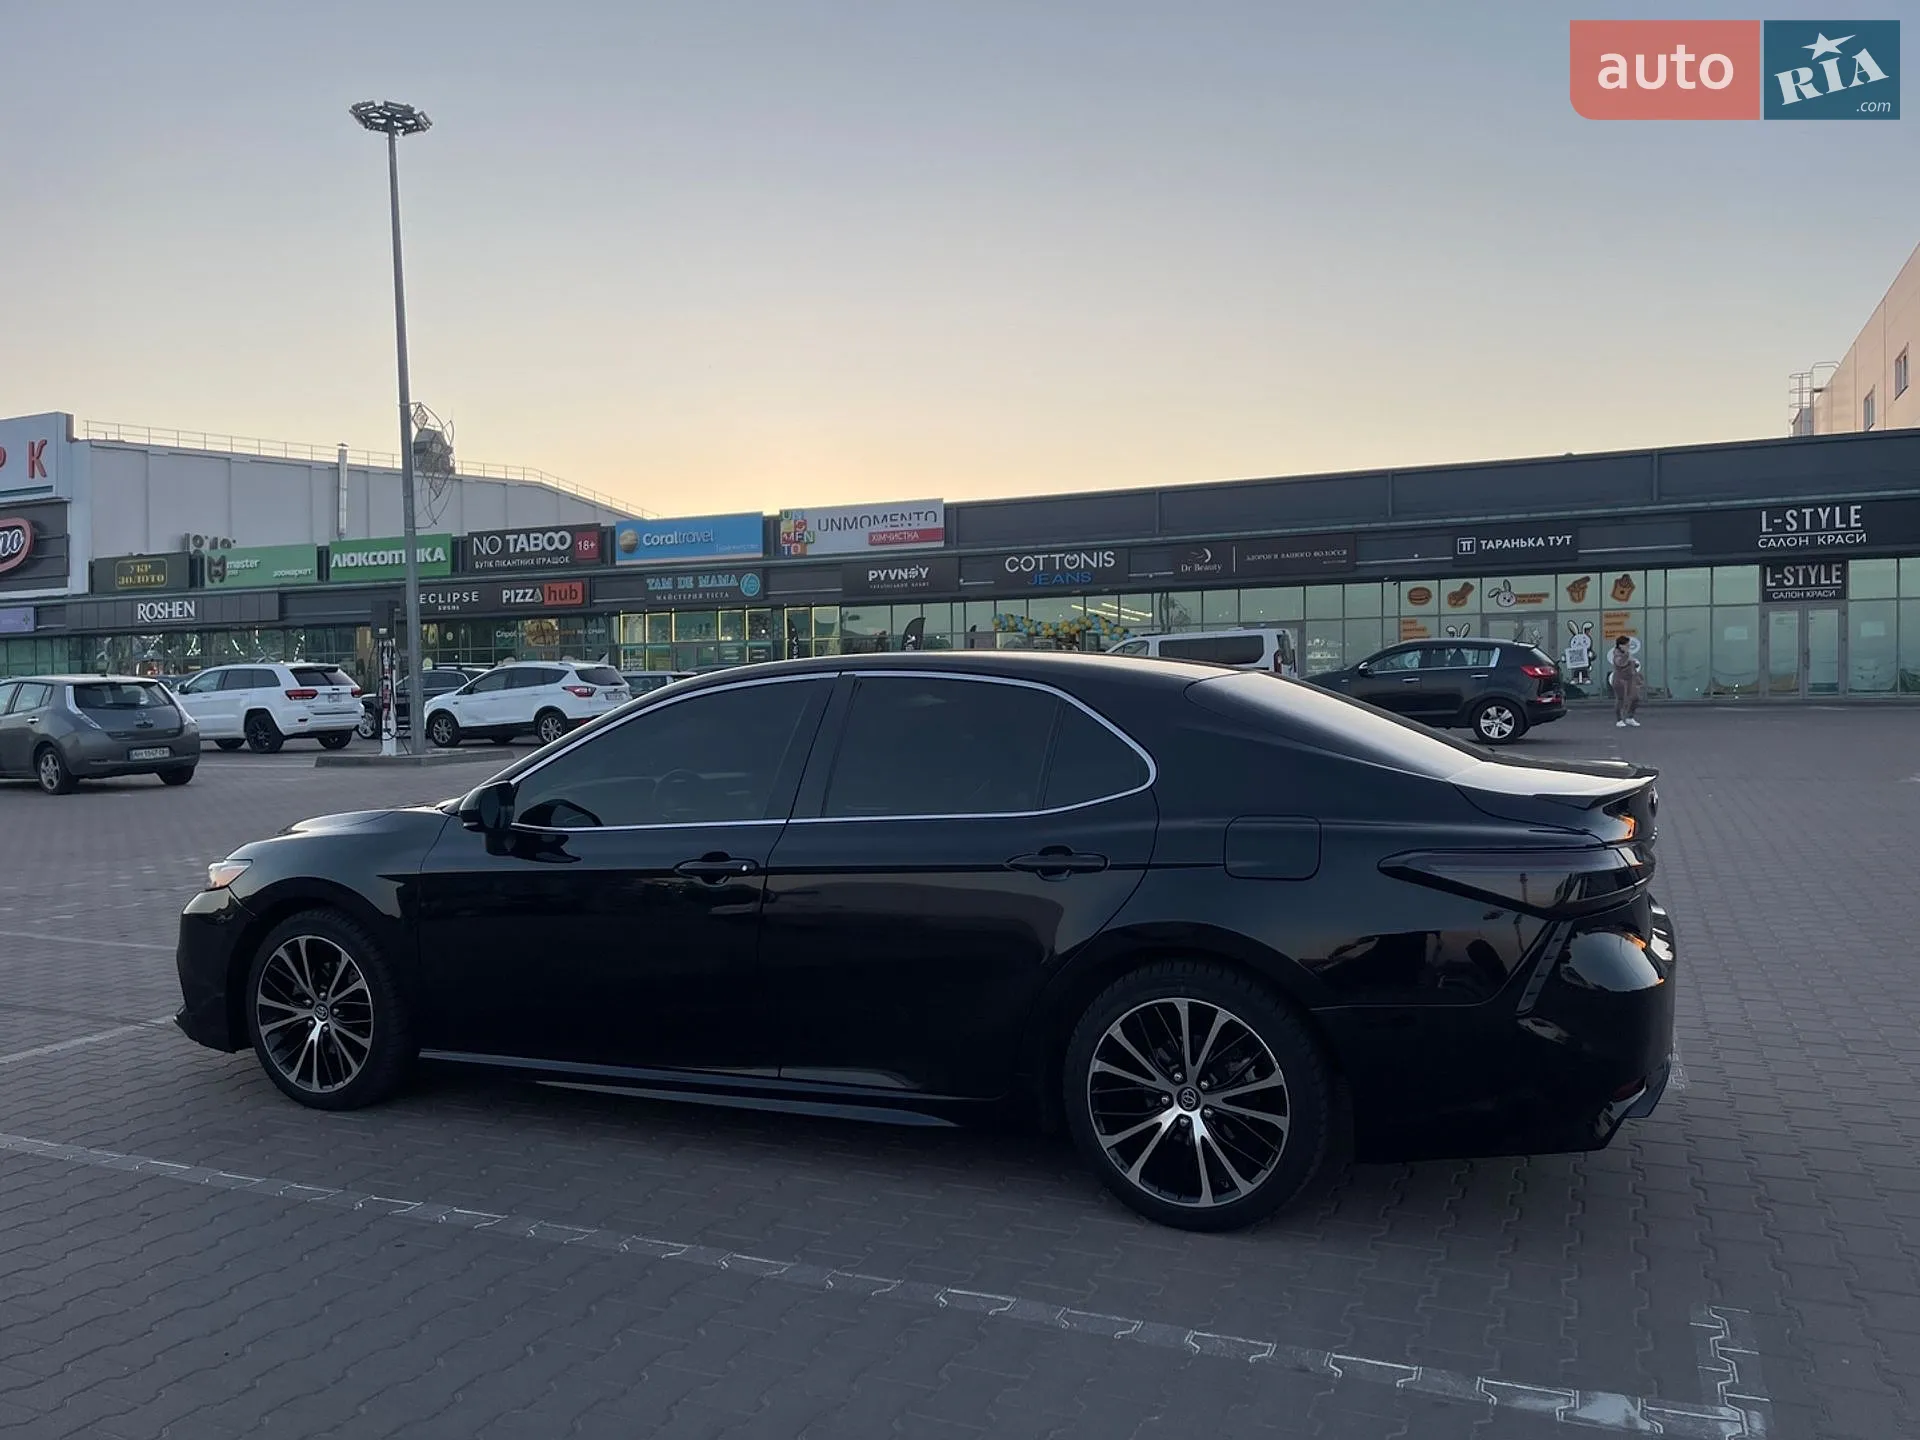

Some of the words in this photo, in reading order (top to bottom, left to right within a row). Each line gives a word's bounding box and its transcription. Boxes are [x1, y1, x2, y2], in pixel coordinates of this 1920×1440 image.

[817, 510, 937, 532] UNMOMENTO
[1761, 505, 1862, 532] L-STYLE
[473, 535, 502, 555] NO
[506, 530, 572, 553] TABOO
[577, 539, 596, 551] 18+
[1480, 537, 1545, 550] ТАРАНЬКА
[1547, 535, 1572, 546] ТУТ
[1758, 536, 1809, 548] САЛОН
[1817, 533, 1867, 545] КРАСИ
[1005, 551, 1115, 573] COTTONIS
[1181, 564, 1191, 572] Dr
[1031, 571, 1092, 586] JEANS
[1766, 564, 1842, 586] L-STYLE
[419, 590, 480, 604] ECLIPSE
[547, 585, 578, 601] hub
[1772, 591, 1804, 599] САЛОН
[137, 600, 195, 623] ROSHEN
